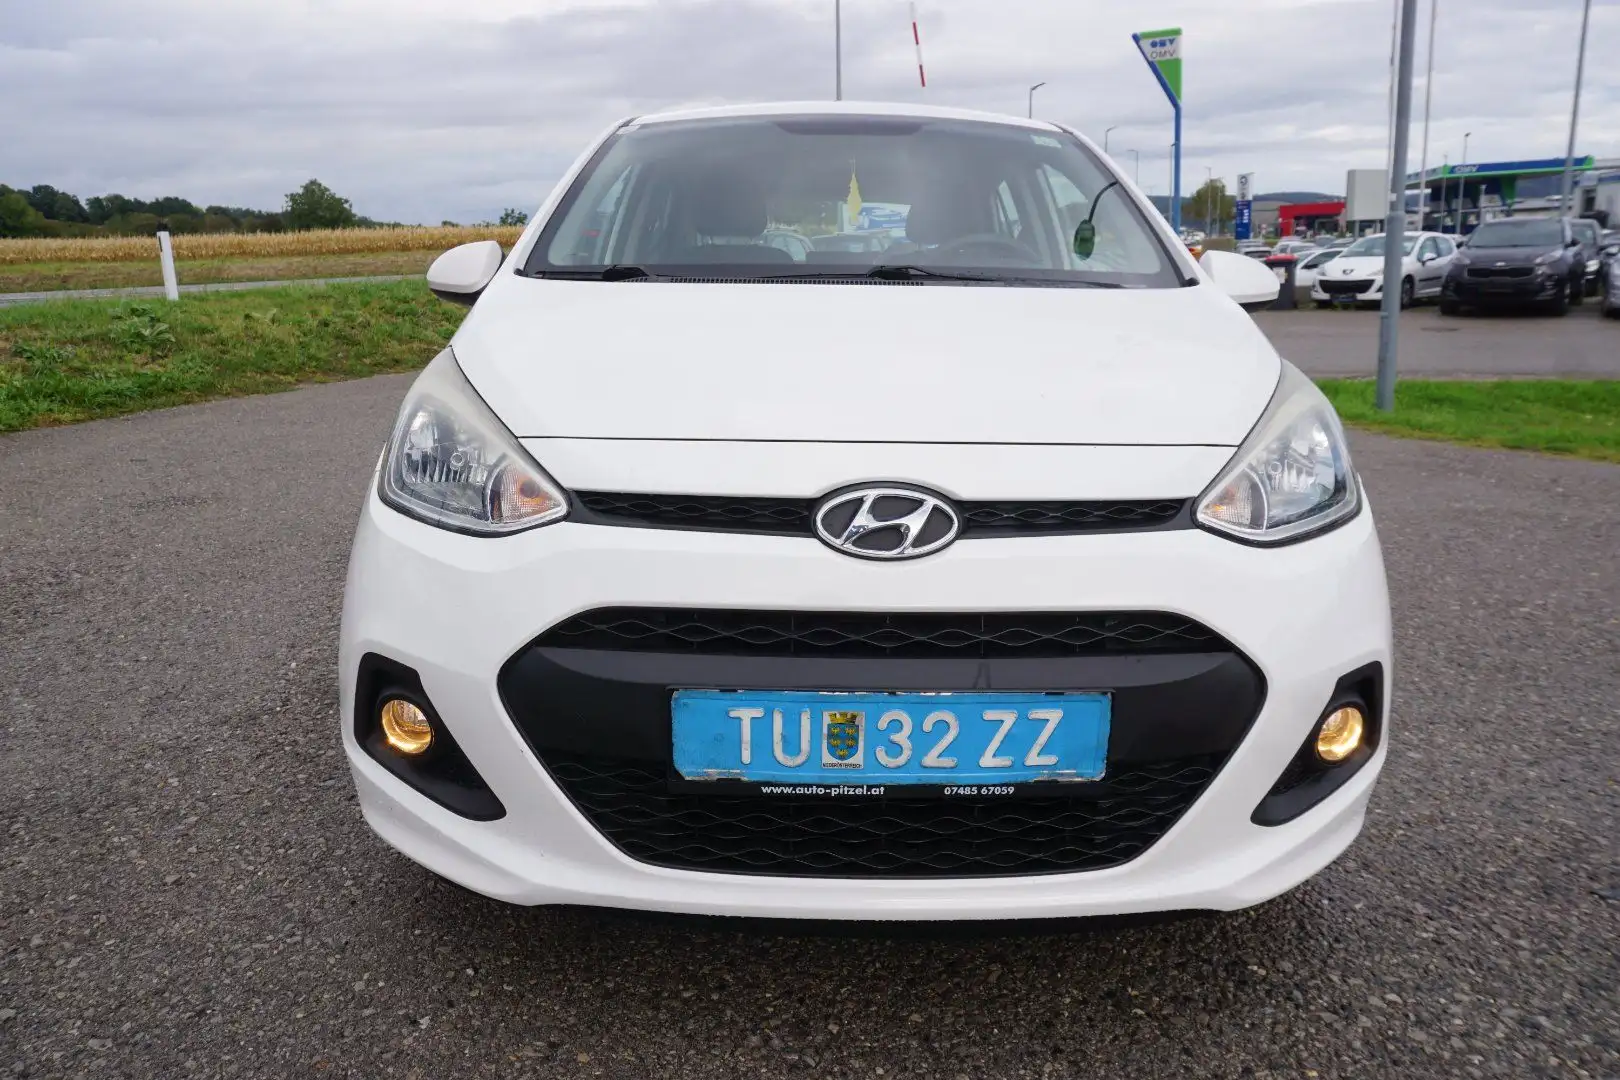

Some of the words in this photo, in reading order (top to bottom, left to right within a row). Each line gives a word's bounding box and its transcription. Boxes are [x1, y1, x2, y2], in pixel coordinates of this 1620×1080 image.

[1150, 49, 1176, 60] OMV
[728, 707, 812, 768] TU
[874, 710, 960, 769] 32
[978, 708, 1064, 768] ZZ
[760, 785, 885, 797] www.auto-pitzel.at
[944, 786, 978, 795] 07485
[980, 786, 1015, 795] 67059
